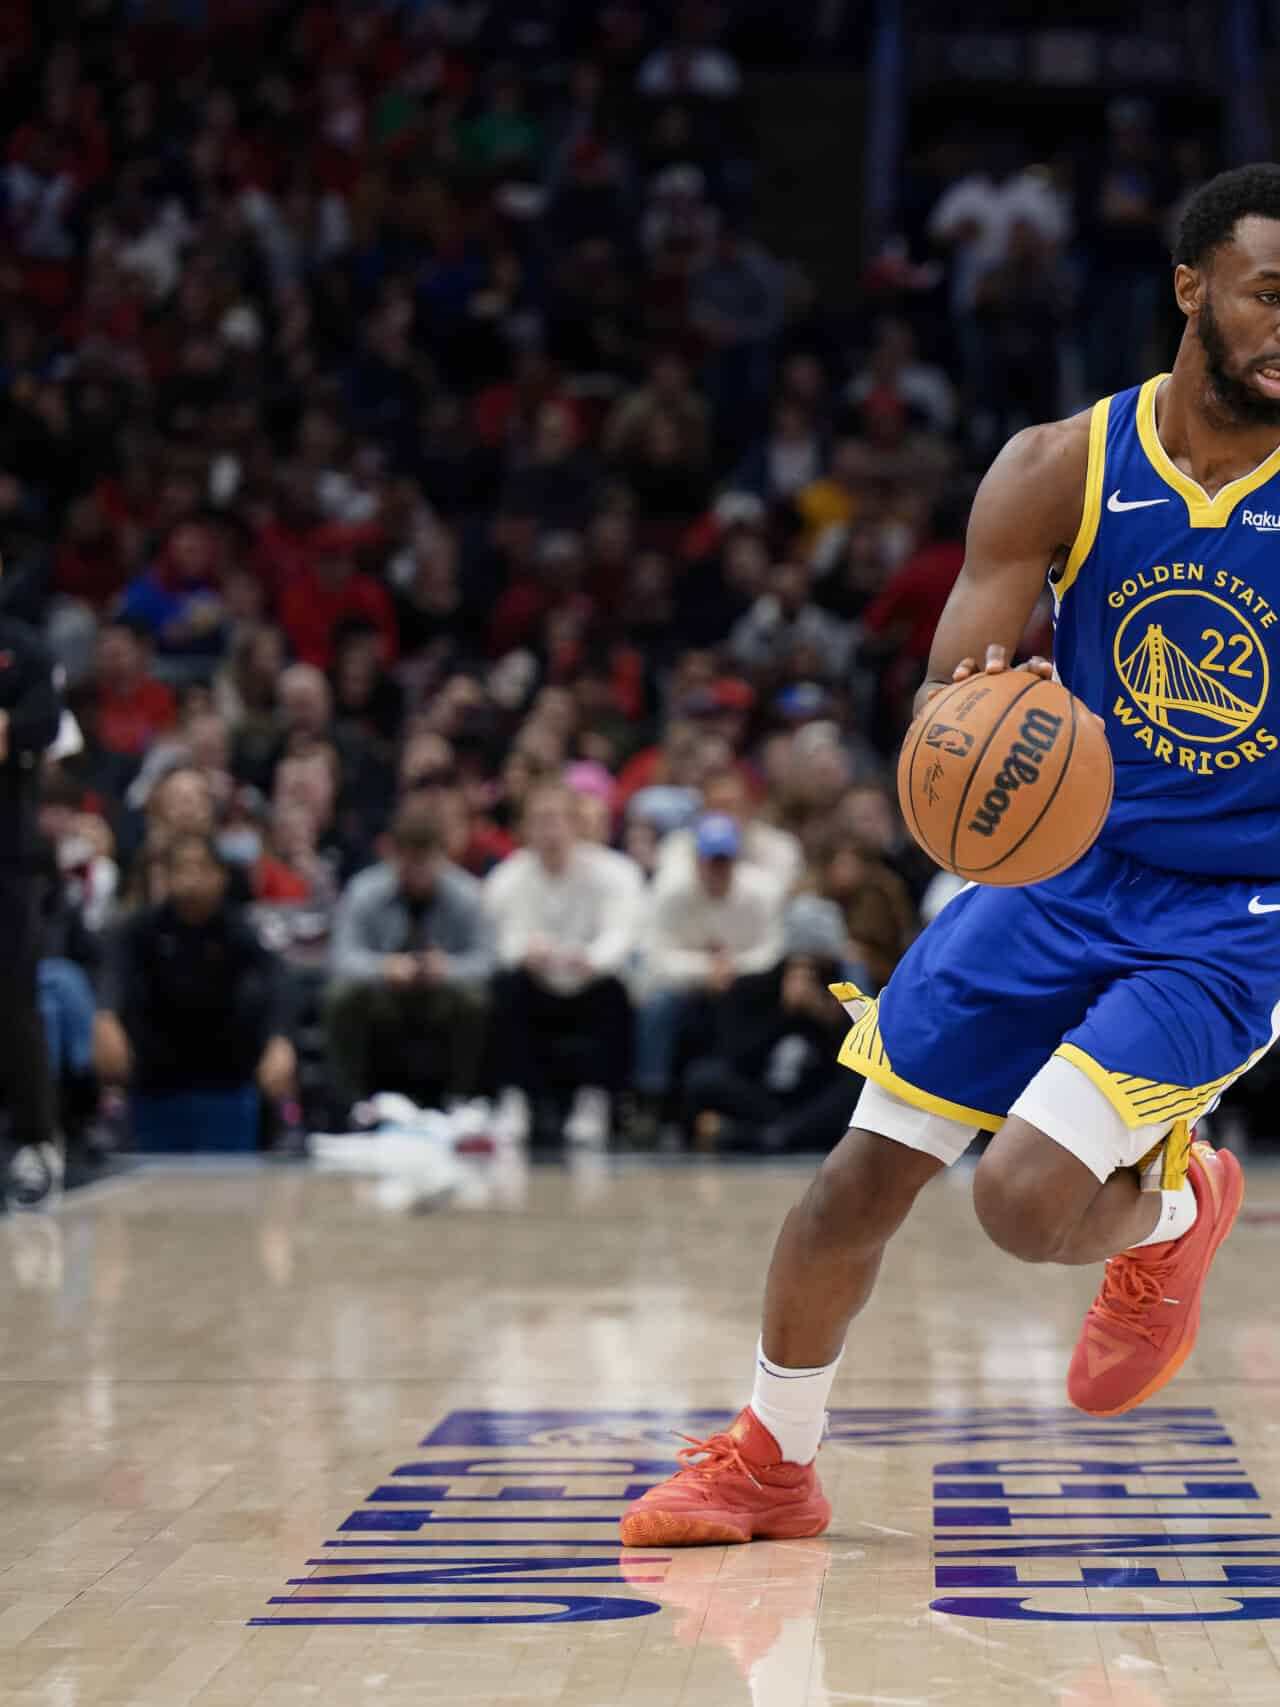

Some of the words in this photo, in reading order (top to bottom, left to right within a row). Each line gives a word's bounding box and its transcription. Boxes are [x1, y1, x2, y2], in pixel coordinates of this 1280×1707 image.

[1108, 563, 1204, 609] GOLDEN
[1214, 571, 1279, 629] STATE
[1200, 628, 1254, 678] 22
[968, 708, 1064, 837] Wilson
[1112, 696, 1279, 775] WARRIORS
[246, 1457, 686, 1626] UNITED
